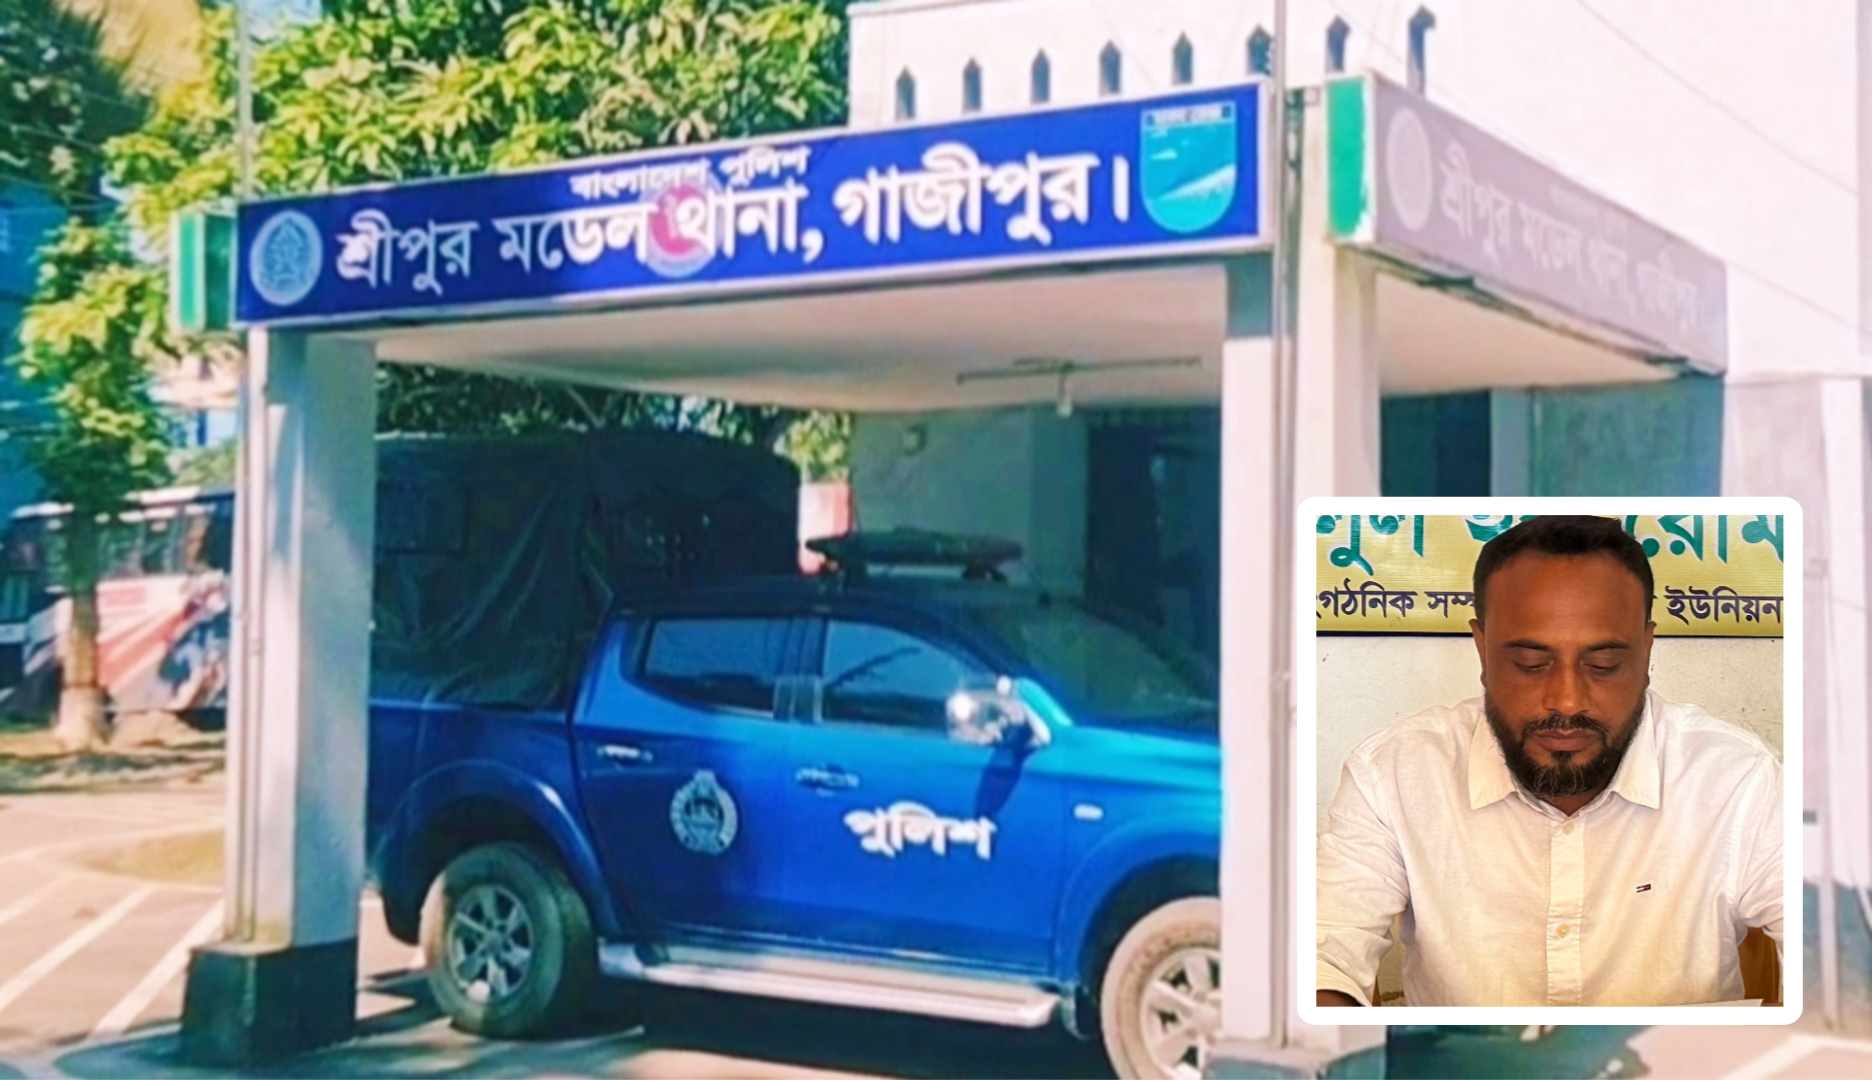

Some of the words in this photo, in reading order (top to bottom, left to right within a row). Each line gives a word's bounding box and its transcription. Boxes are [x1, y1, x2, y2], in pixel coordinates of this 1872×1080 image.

[719, 145, 811, 188] পুলিশ
[335, 207, 480, 297] শ্রীপুর
[490, 198, 660, 275] মডেল
[672, 174, 824, 265] থানা,
[1664, 585, 1784, 626] ইউনিয়ন
[843, 800, 998, 861] পুলিশ
